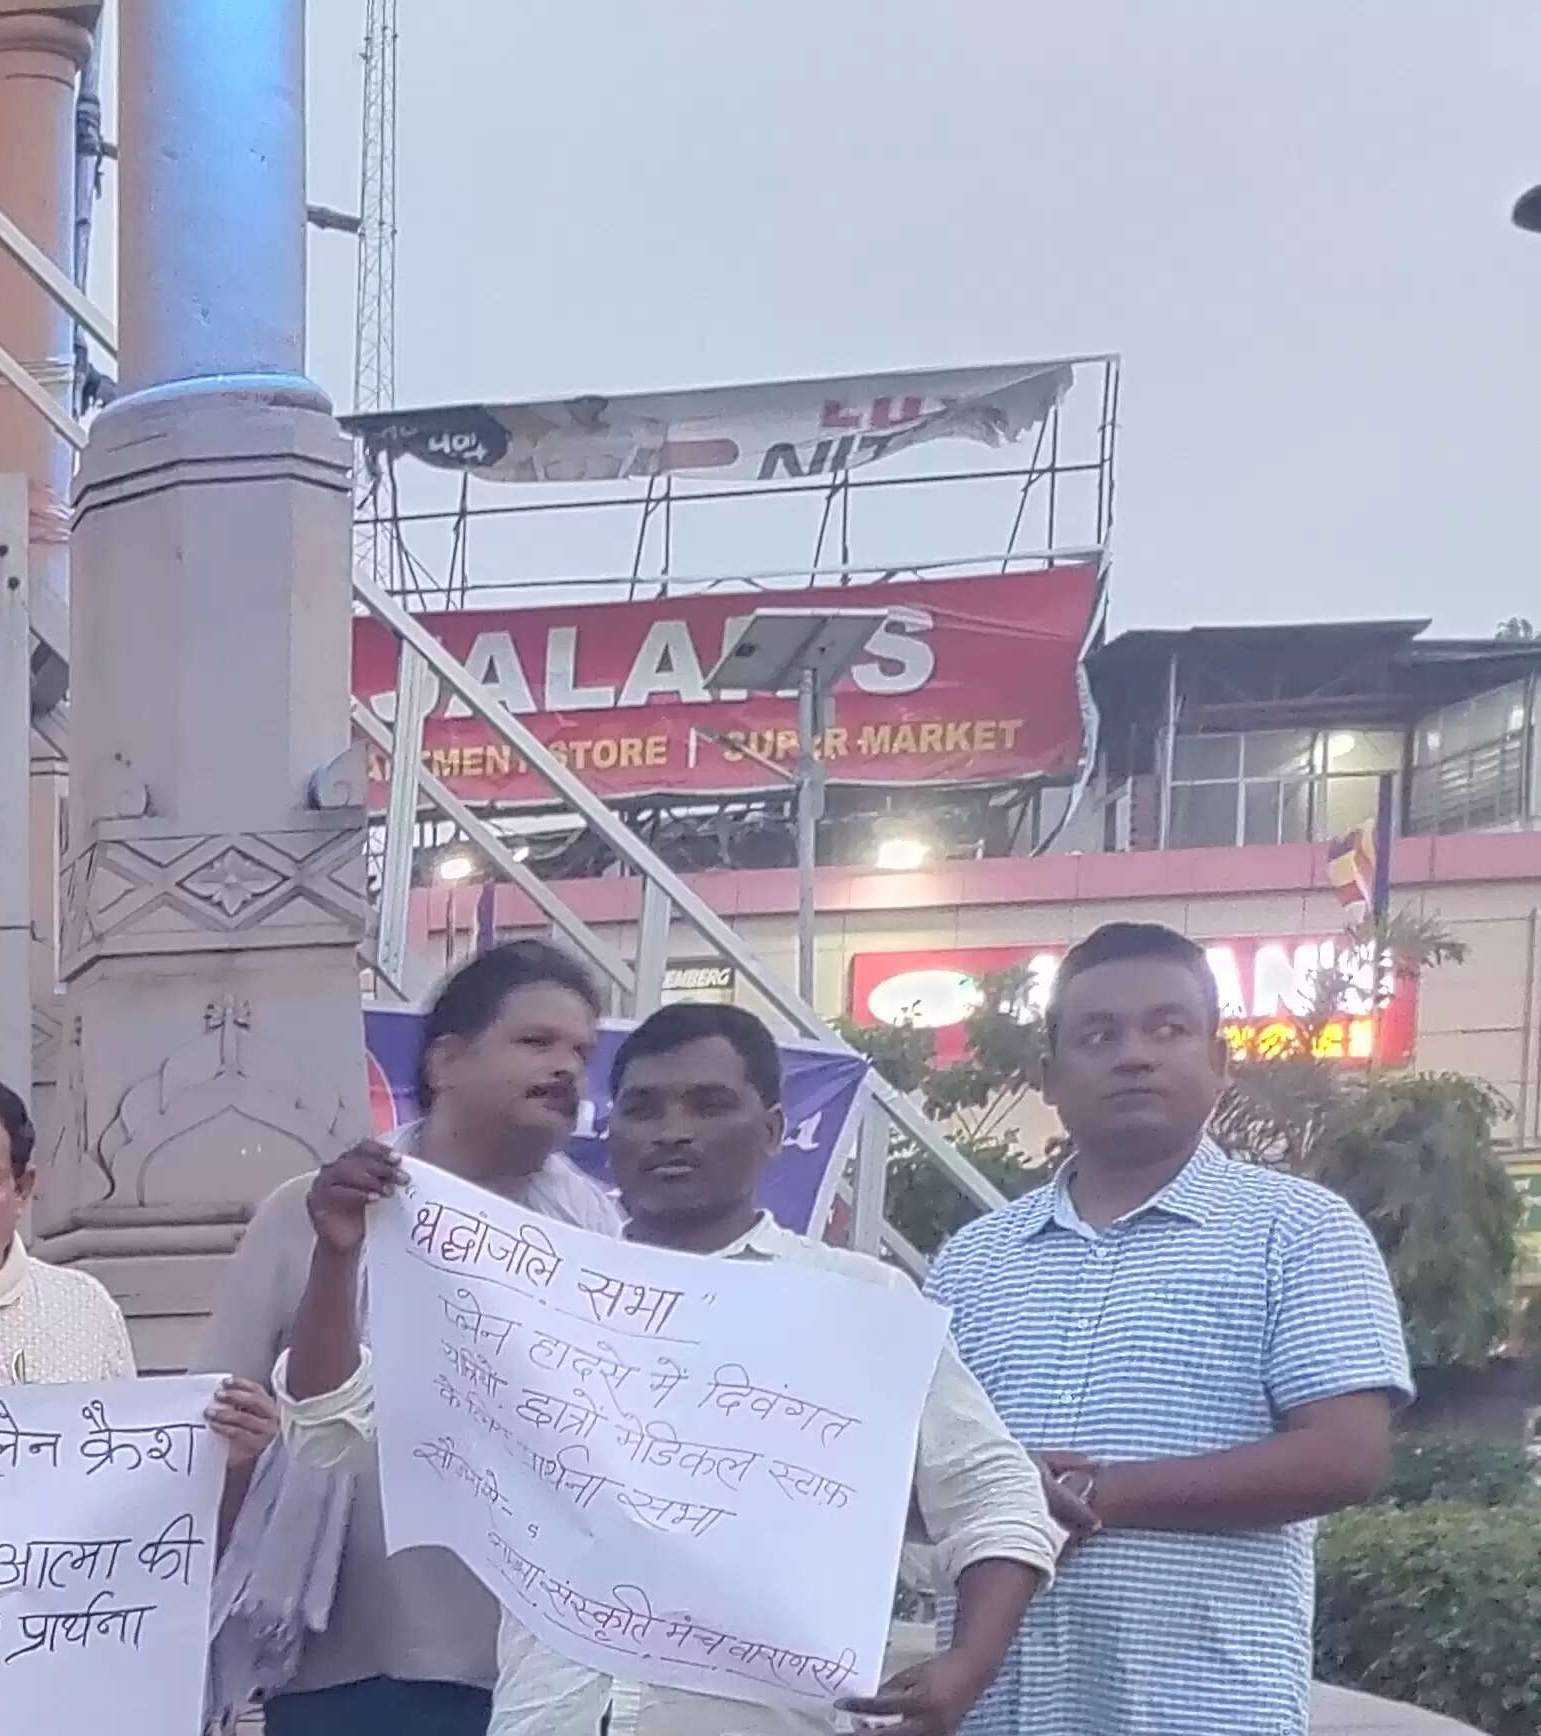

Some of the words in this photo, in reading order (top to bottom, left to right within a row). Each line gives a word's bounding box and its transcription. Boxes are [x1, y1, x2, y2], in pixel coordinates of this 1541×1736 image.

[861, 719, 1023, 756] MARKET
[650, 1356, 689, 1409] में
[80, 1399, 206, 1477] क्रैश
[617, 1488, 739, 1538] सभा
[138, 1512, 205, 1586] की
[4, 1590, 159, 1665] प्रार्थना
